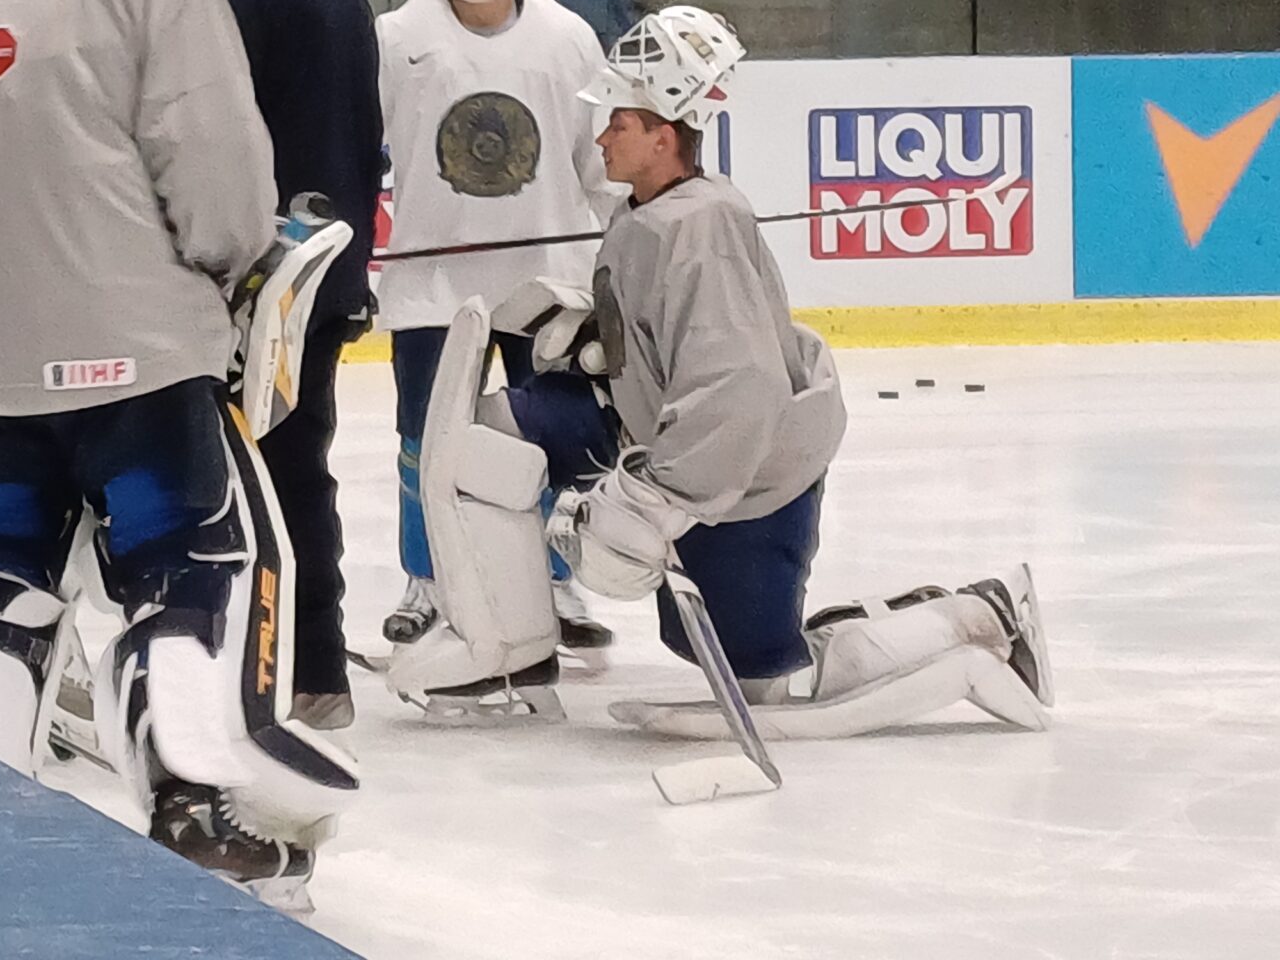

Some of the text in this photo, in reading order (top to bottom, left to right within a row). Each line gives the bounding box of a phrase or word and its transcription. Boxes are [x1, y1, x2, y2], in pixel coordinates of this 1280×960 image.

[821, 111, 1021, 181] LIQUI
[821, 187, 1030, 254] MOLY
[257, 566, 277, 695] TRUE
